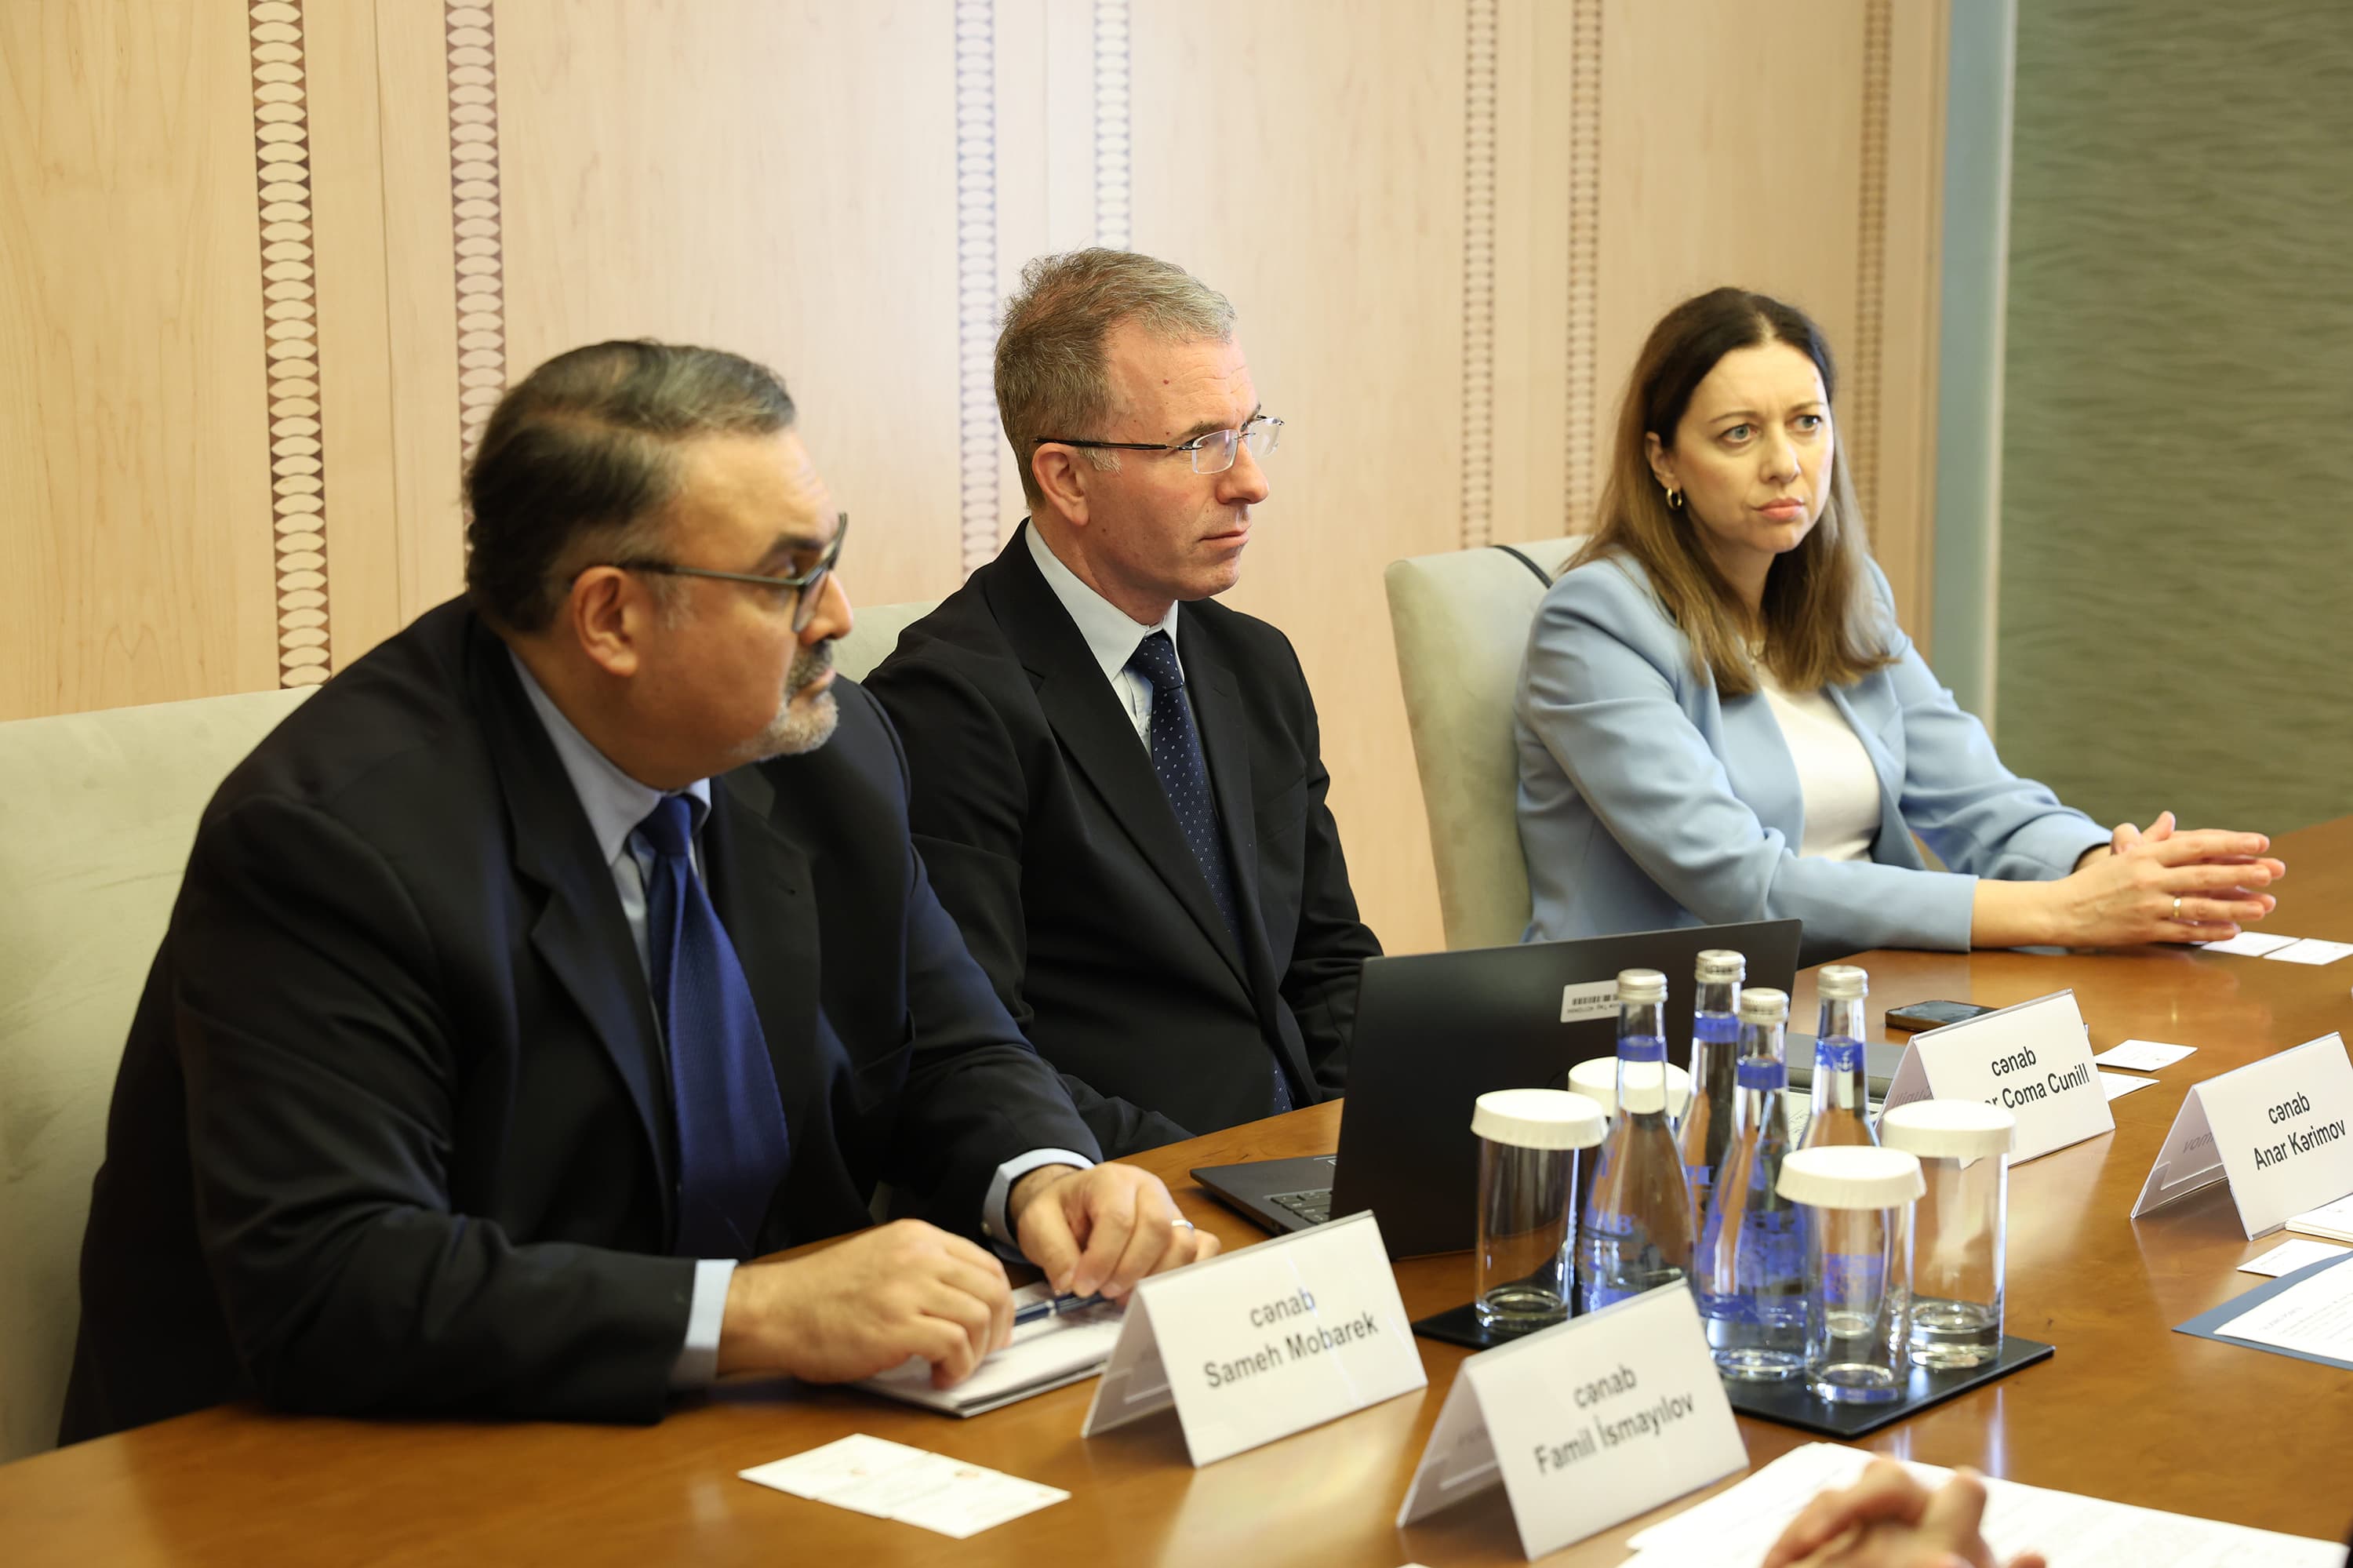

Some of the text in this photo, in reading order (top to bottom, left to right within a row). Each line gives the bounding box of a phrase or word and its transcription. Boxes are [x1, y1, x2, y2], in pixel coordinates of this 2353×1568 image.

[1991, 1046, 2036, 1076] cənab
[2002, 1063, 2090, 1109] Coma Cunill
[2268, 1091, 2311, 1124] cənab
[2253, 1119, 2346, 1170] Anar Kərimov
[1249, 1287, 1316, 1328] cənab
[1203, 1310, 1380, 1388] Sameh Mobarek
[1533, 1427, 1598, 1475] Famil
